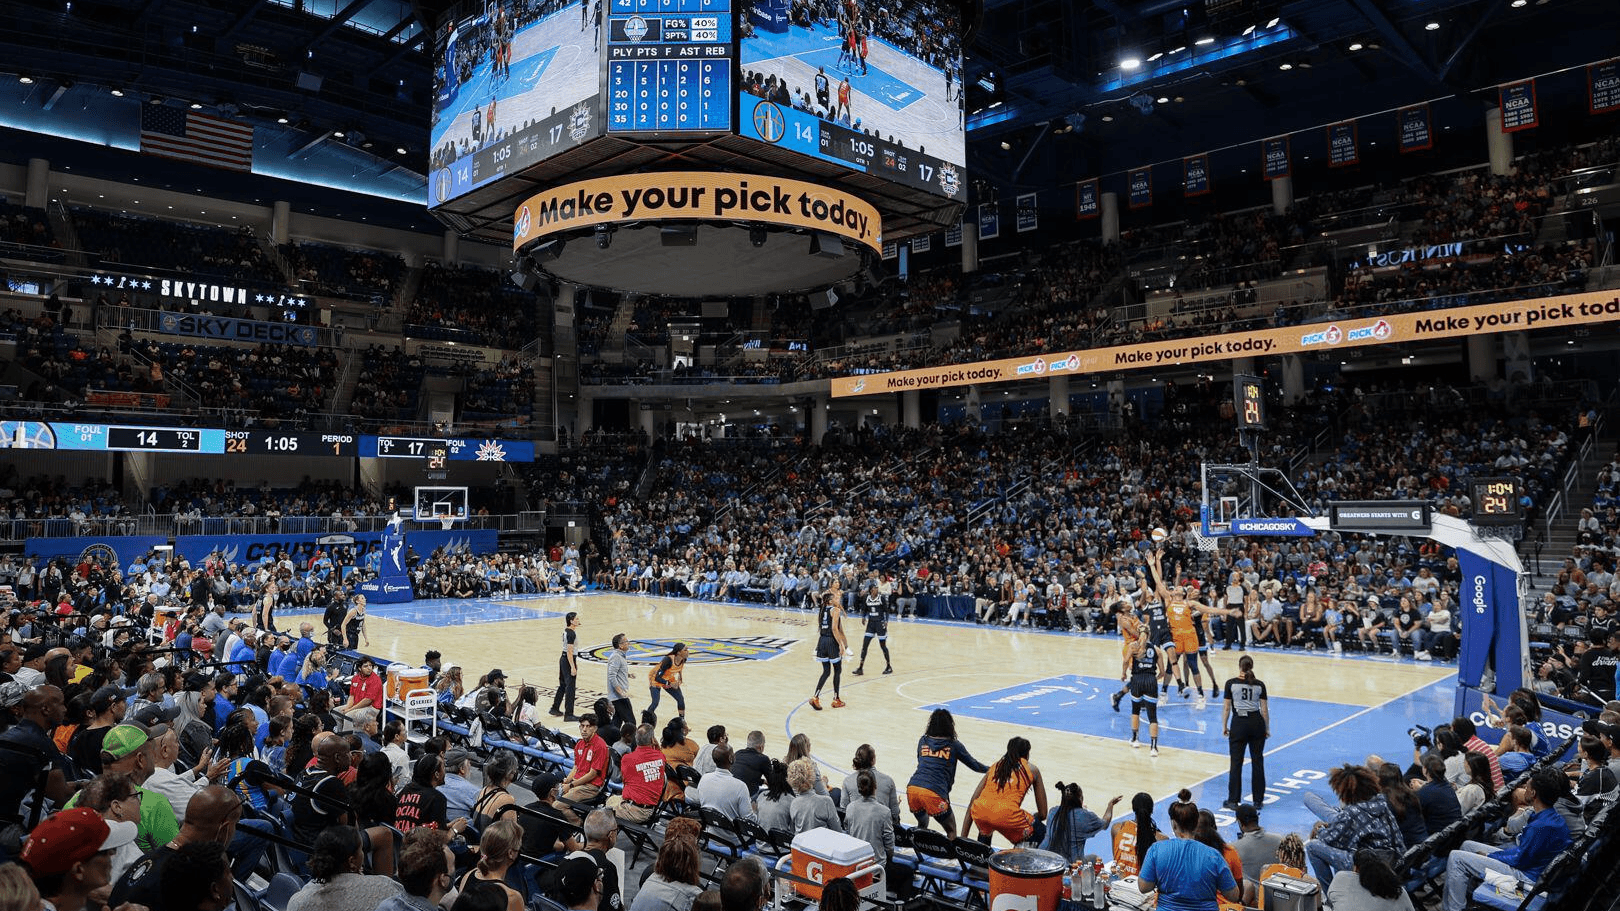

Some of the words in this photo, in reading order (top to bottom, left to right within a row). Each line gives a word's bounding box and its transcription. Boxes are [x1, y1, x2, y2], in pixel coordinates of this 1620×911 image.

[665, 20, 686, 28] FG%
[613, 48, 632, 56] PLY
[637, 48, 657, 56] PTS
[680, 47, 700, 55] AST
[706, 47, 725, 55] REB
[616, 65, 622, 73] 2
[681, 64, 688, 72] 0
[705, 64, 712, 72] 0
[1594, 78, 1620, 89] NCAA
[615, 90, 628, 98] 20
[661, 102, 668, 110] 0
[1505, 98, 1530, 109] NCAA
[680, 114, 687, 122] 0
[704, 114, 708, 122] 1
[1403, 121, 1425, 130] NCAA
[549, 124, 563, 145] 17
[794, 122, 812, 143] 14
[821, 139, 829, 147] 01
[1332, 137, 1352, 146] NCAA
[850, 138, 874, 158] 1:05
[883, 149, 895, 157] SHOT
[493, 145, 511, 163] 1:05
[1266, 151, 1285, 160] NCAA
[885, 157, 894, 167] 24
[898, 163, 906, 172] 02
[457, 167, 468, 185] 14
[919, 164, 933, 182] 17
[1188, 169, 1204, 177] NCAA
[1582, 197, 1598, 206] 226
[539, 190, 613, 228] Make
[622, 187, 705, 217] your
[715, 182, 792, 216] pick
[798, 192, 871, 238] today.
[161, 280, 246, 304] SKYTOWN
[1415, 316, 1469, 333] Make
[1474, 312, 1521, 331] your
[1526, 306, 1574, 325] pick
[1580, 298, 1620, 316] tod
[179, 318, 229, 336] SKY
[237, 322, 298, 343] DECK
[1302, 334, 1324, 344] PICK
[1349, 328, 1372, 340] PICK
[1376, 322, 1386, 336] 4
[1115, 351, 1152, 364] Make
[1155, 347, 1187, 361] your
[1191, 343, 1222, 358] pick
[1226, 338, 1277, 353] today.
[887, 376, 914, 388] Make
[917, 375, 940, 387] your
[941, 370, 965, 383] pick
[967, 367, 1002, 381] today.
[1245, 400, 1258, 424] 24
[74, 425, 102, 434] FOUL
[225, 431, 250, 439] SHOT
[81, 434, 92, 442] 01
[136, 432, 157, 445] 14
[176, 432, 194, 440] TOL
[322, 435, 352, 443] PERIOD
[182, 440, 188, 448] 2
[227, 441, 246, 452] 24
[265, 436, 298, 450] 1:05
[380, 439, 394, 447] TOL
[408, 443, 424, 454] 17
[333, 443, 340, 455] 1
[430, 457, 443, 468] 24
[1488, 483, 1513, 495] 1:04
[1485, 497, 1506, 513] 24
[1411, 510, 1420, 520] G
[1239, 523, 1296, 531] @CHICAGOSKY
[1472, 575, 1486, 614] Google
[1243, 689, 1254, 702] 31
[921, 748, 950, 760] SUN
[399, 794, 421, 804] ANTI
[396, 806, 421, 820] OCIAL
[916, 842, 948, 854] WNBA
[806, 862, 823, 882] G
